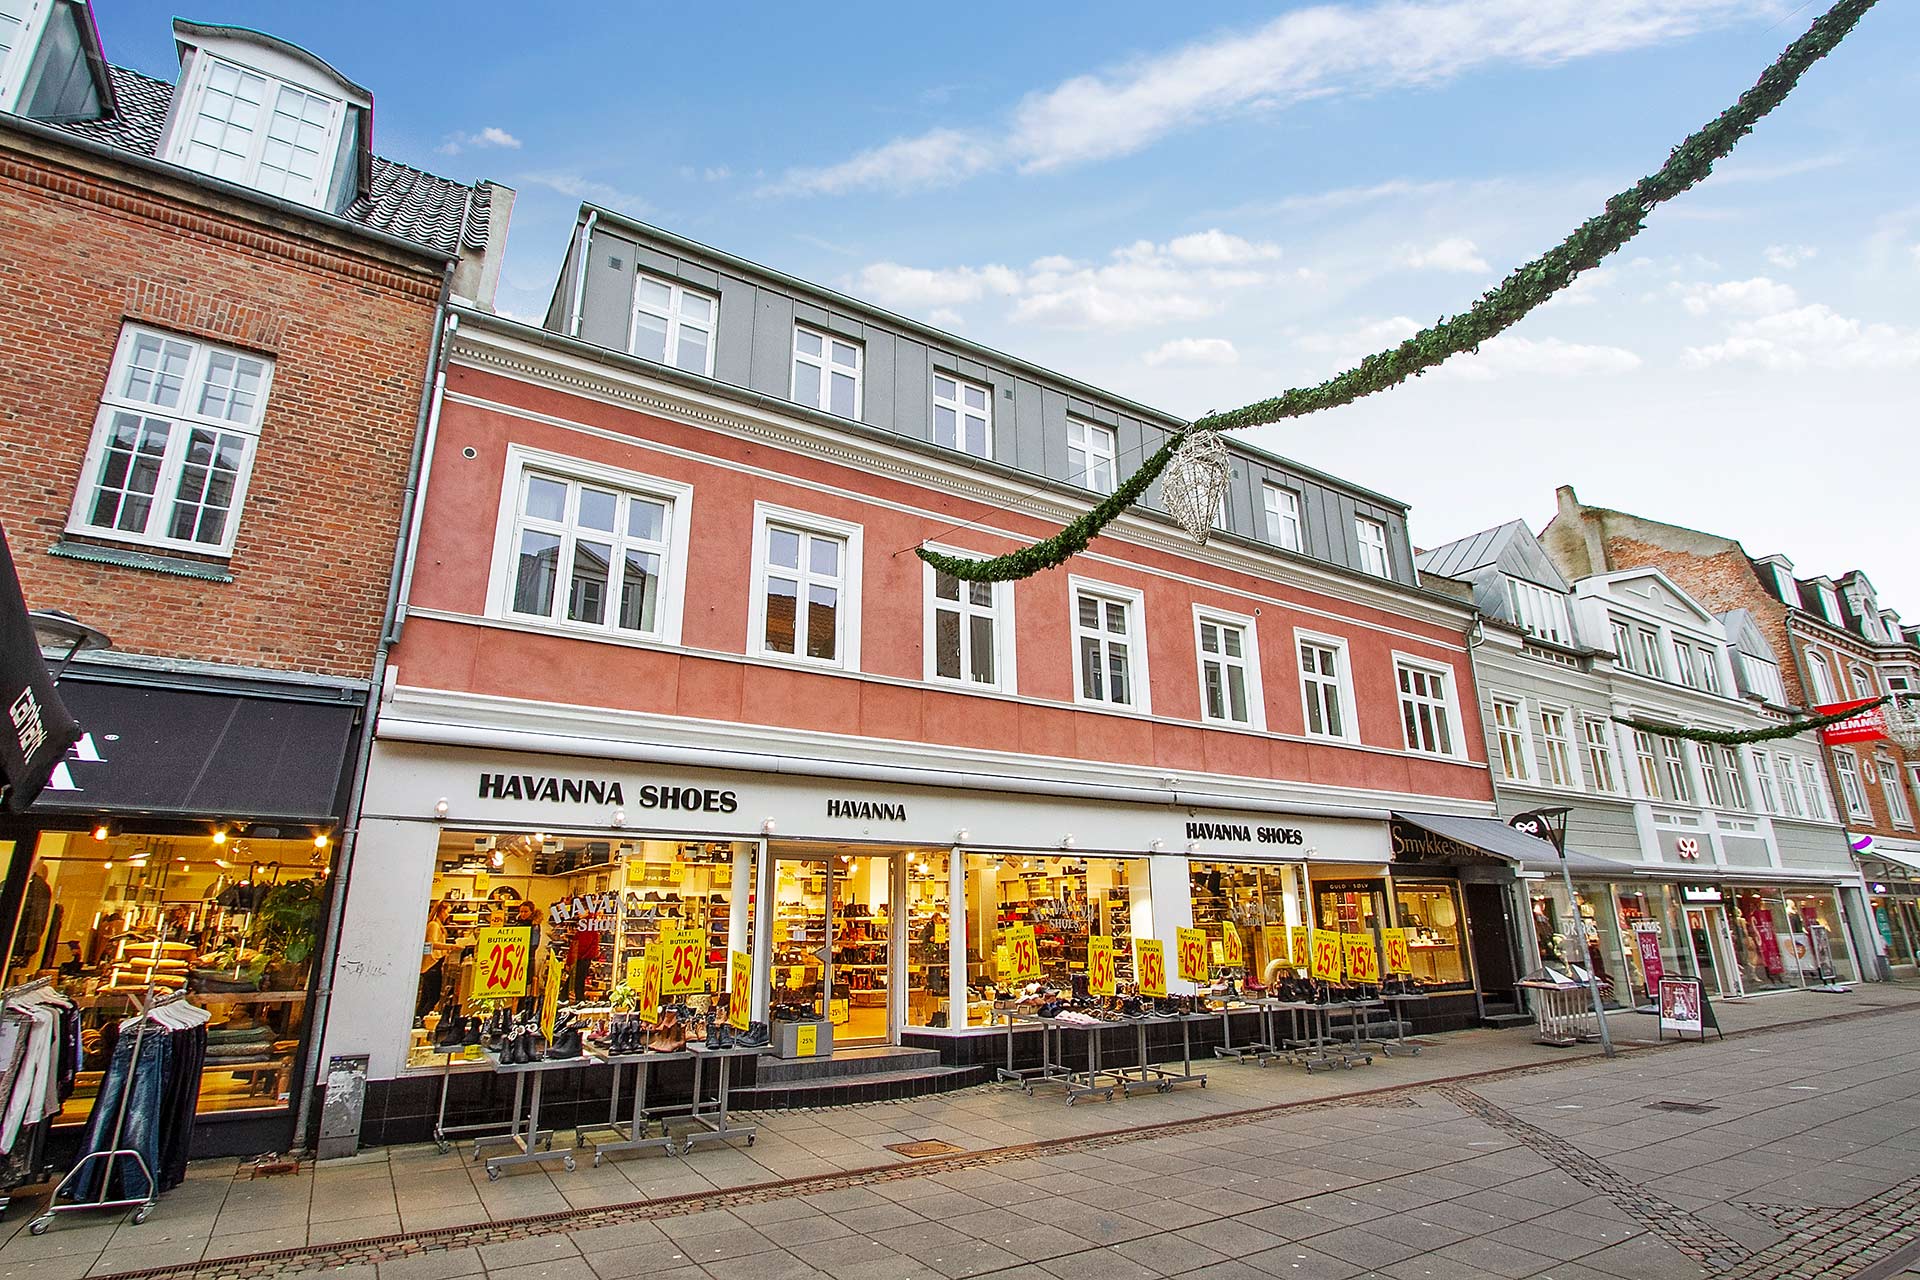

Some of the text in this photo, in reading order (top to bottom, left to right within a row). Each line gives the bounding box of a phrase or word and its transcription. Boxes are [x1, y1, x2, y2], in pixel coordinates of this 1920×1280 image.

[478, 773, 738, 813] HAVANNA SHOES
[827, 799, 907, 822] HAVANNA
[1185, 822, 1304, 846] HAVANNA SHOES
[550, 895, 657, 924] HAVANNA
[577, 918, 630, 932] SHOES
[1641, 943, 1658, 960] SALE
